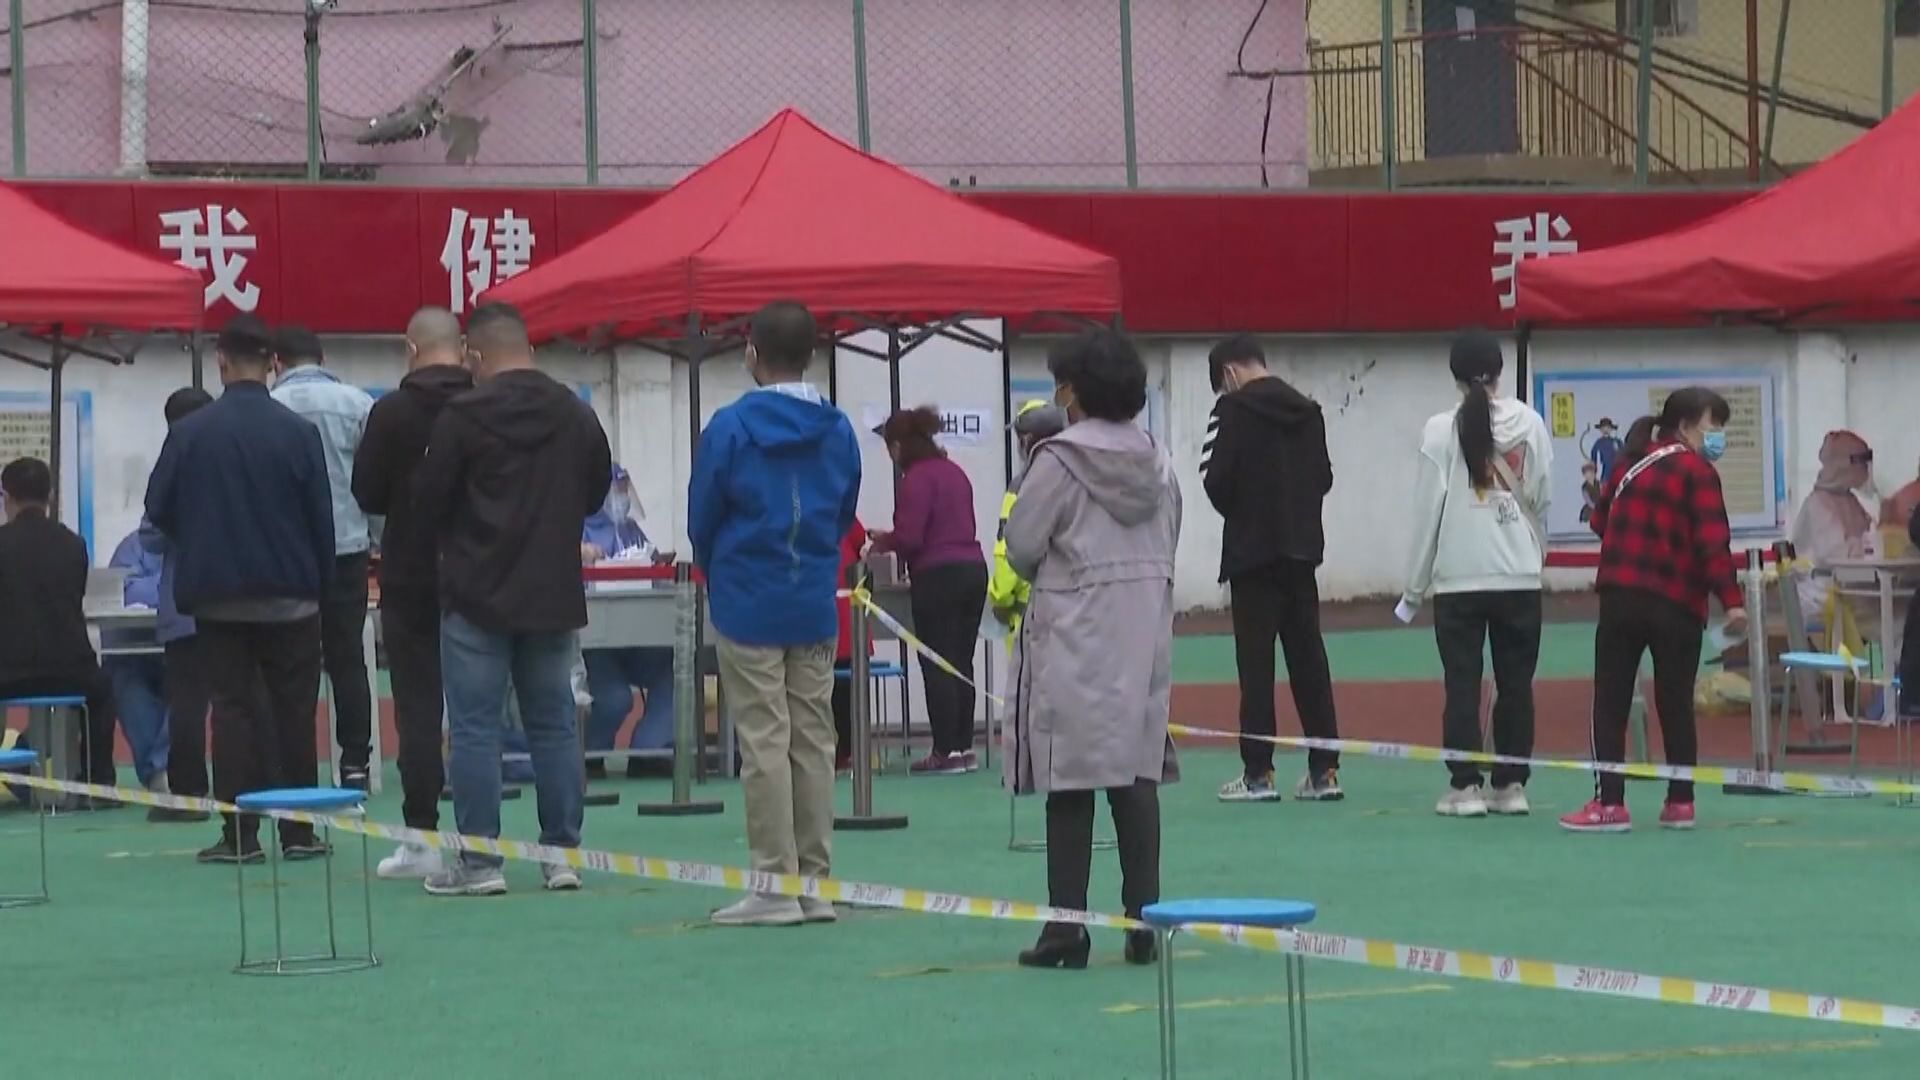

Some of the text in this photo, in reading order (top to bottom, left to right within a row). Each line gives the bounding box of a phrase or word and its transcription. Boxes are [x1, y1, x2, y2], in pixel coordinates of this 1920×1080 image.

[158, 203, 261, 312] 我
[440, 207, 535, 314] 健
[940, 412, 980, 435] 出口
